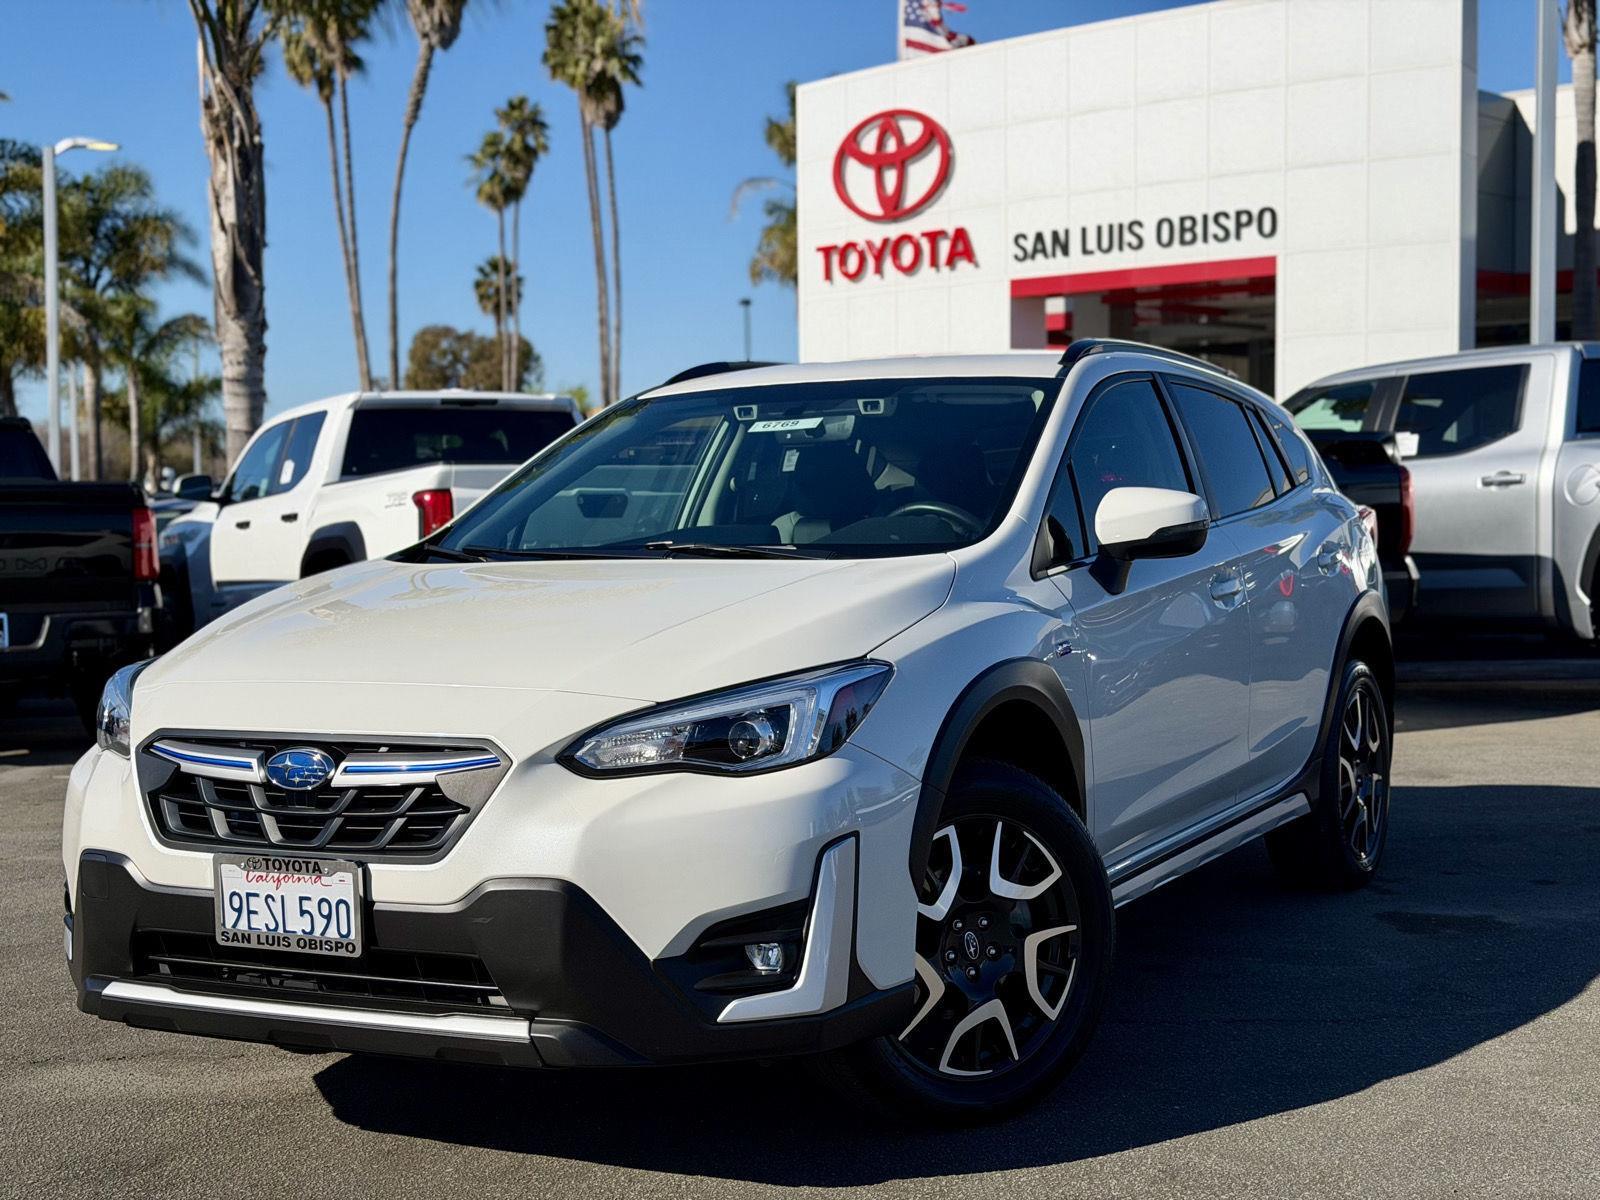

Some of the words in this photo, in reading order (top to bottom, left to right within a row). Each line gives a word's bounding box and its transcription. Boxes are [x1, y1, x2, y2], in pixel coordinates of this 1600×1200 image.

[1013, 228, 1071, 263] SAN
[1081, 220, 1145, 256] LUIS
[1156, 206, 1278, 248] OBISPO
[816, 226, 978, 284] TOYOTA
[761, 420, 799, 429] 6769
[262, 857, 323, 875] TOYOTA
[245, 870, 333, 891] California
[228, 890, 352, 939] 9ESL590
[221, 930, 251, 945] SAN
[257, 934, 292, 949] LUIS
[296, 937, 357, 954] OBISPO
